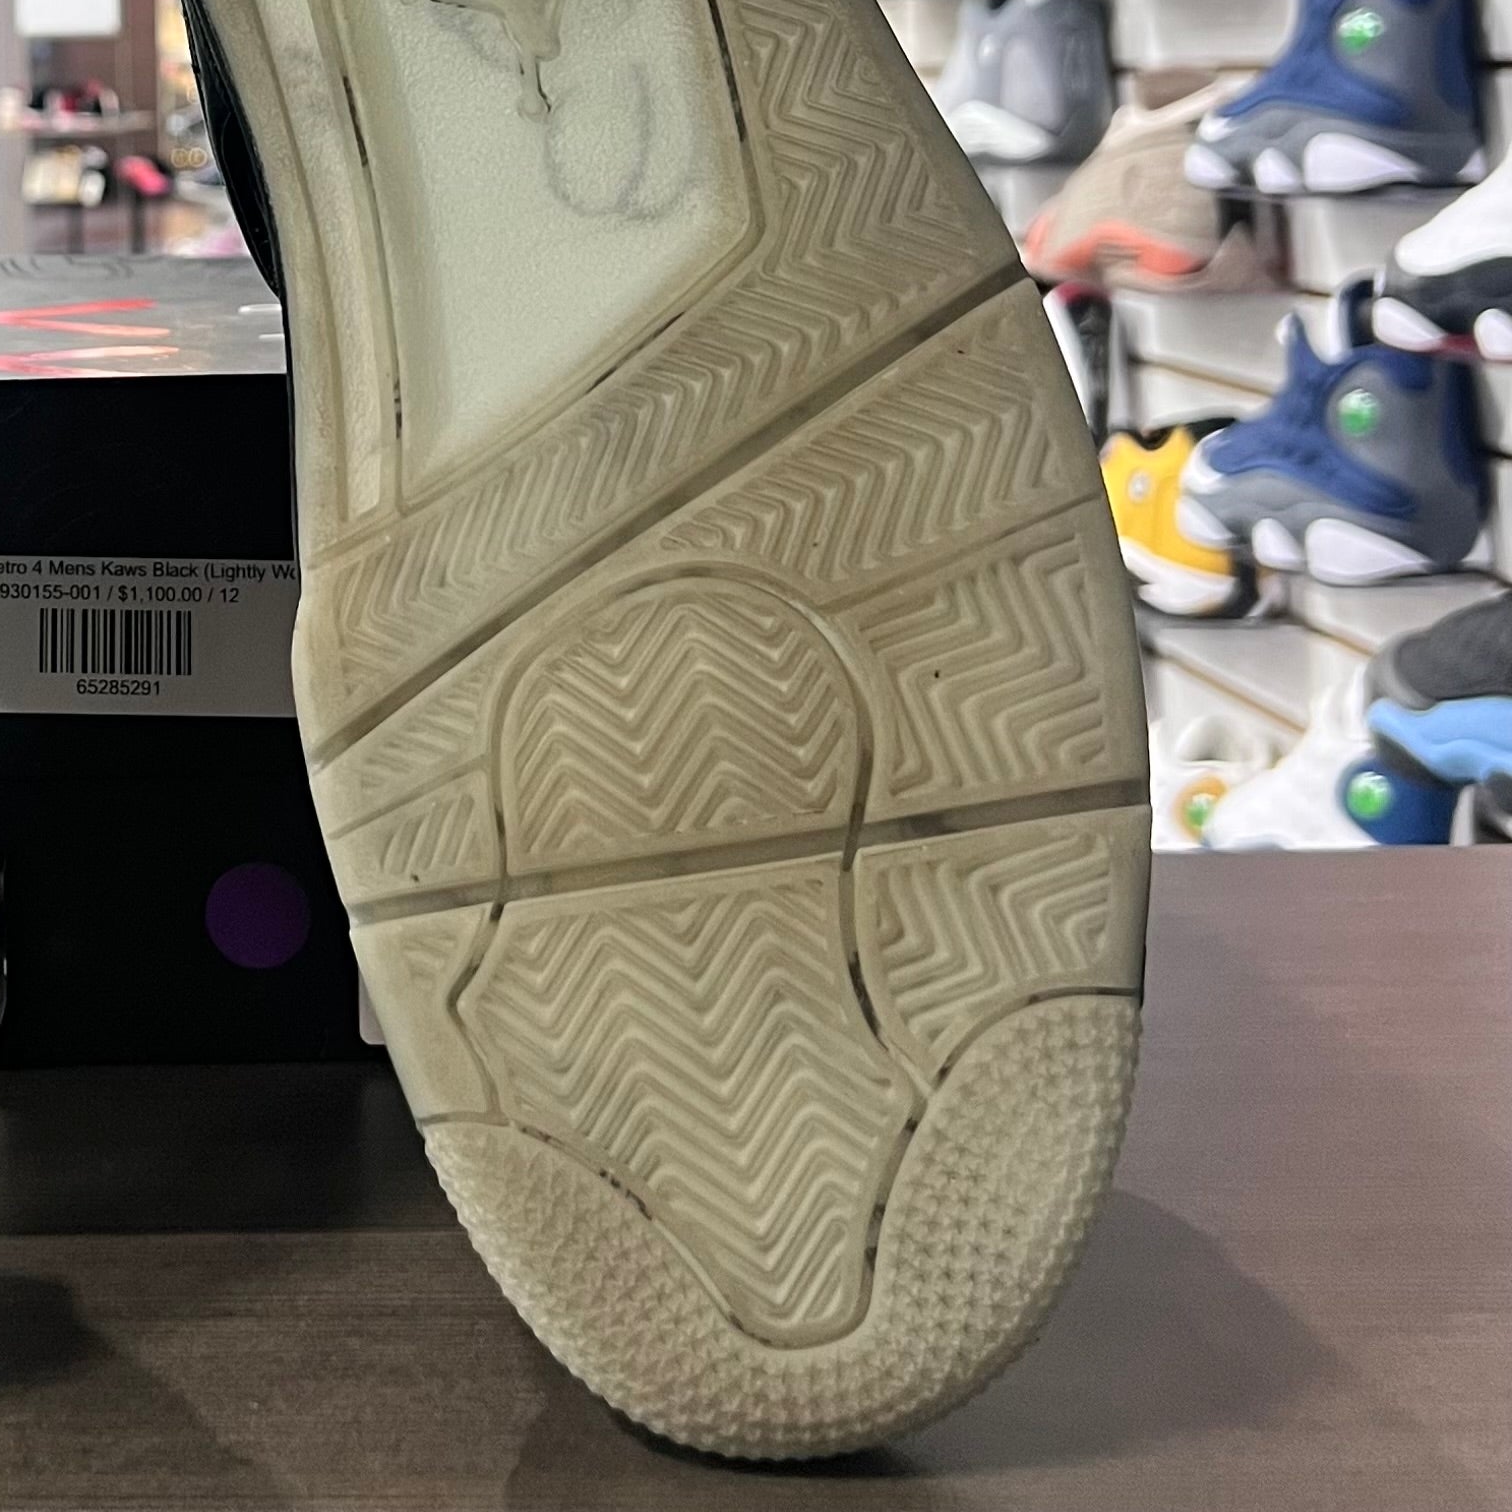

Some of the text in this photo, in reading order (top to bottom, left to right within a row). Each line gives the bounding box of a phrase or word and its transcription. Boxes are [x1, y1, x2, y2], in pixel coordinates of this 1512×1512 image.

[32, 560, 42, 575] 4
[49, 560, 96, 576] Mens
[101, 561, 147, 577] Kaws
[153, 562, 199, 578] Black
[204, 563, 266, 583] (Lightly
[0, 583, 240, 604] 930155-001 / $1,100.00 / 12
[76, 679, 160, 696] 65285291
